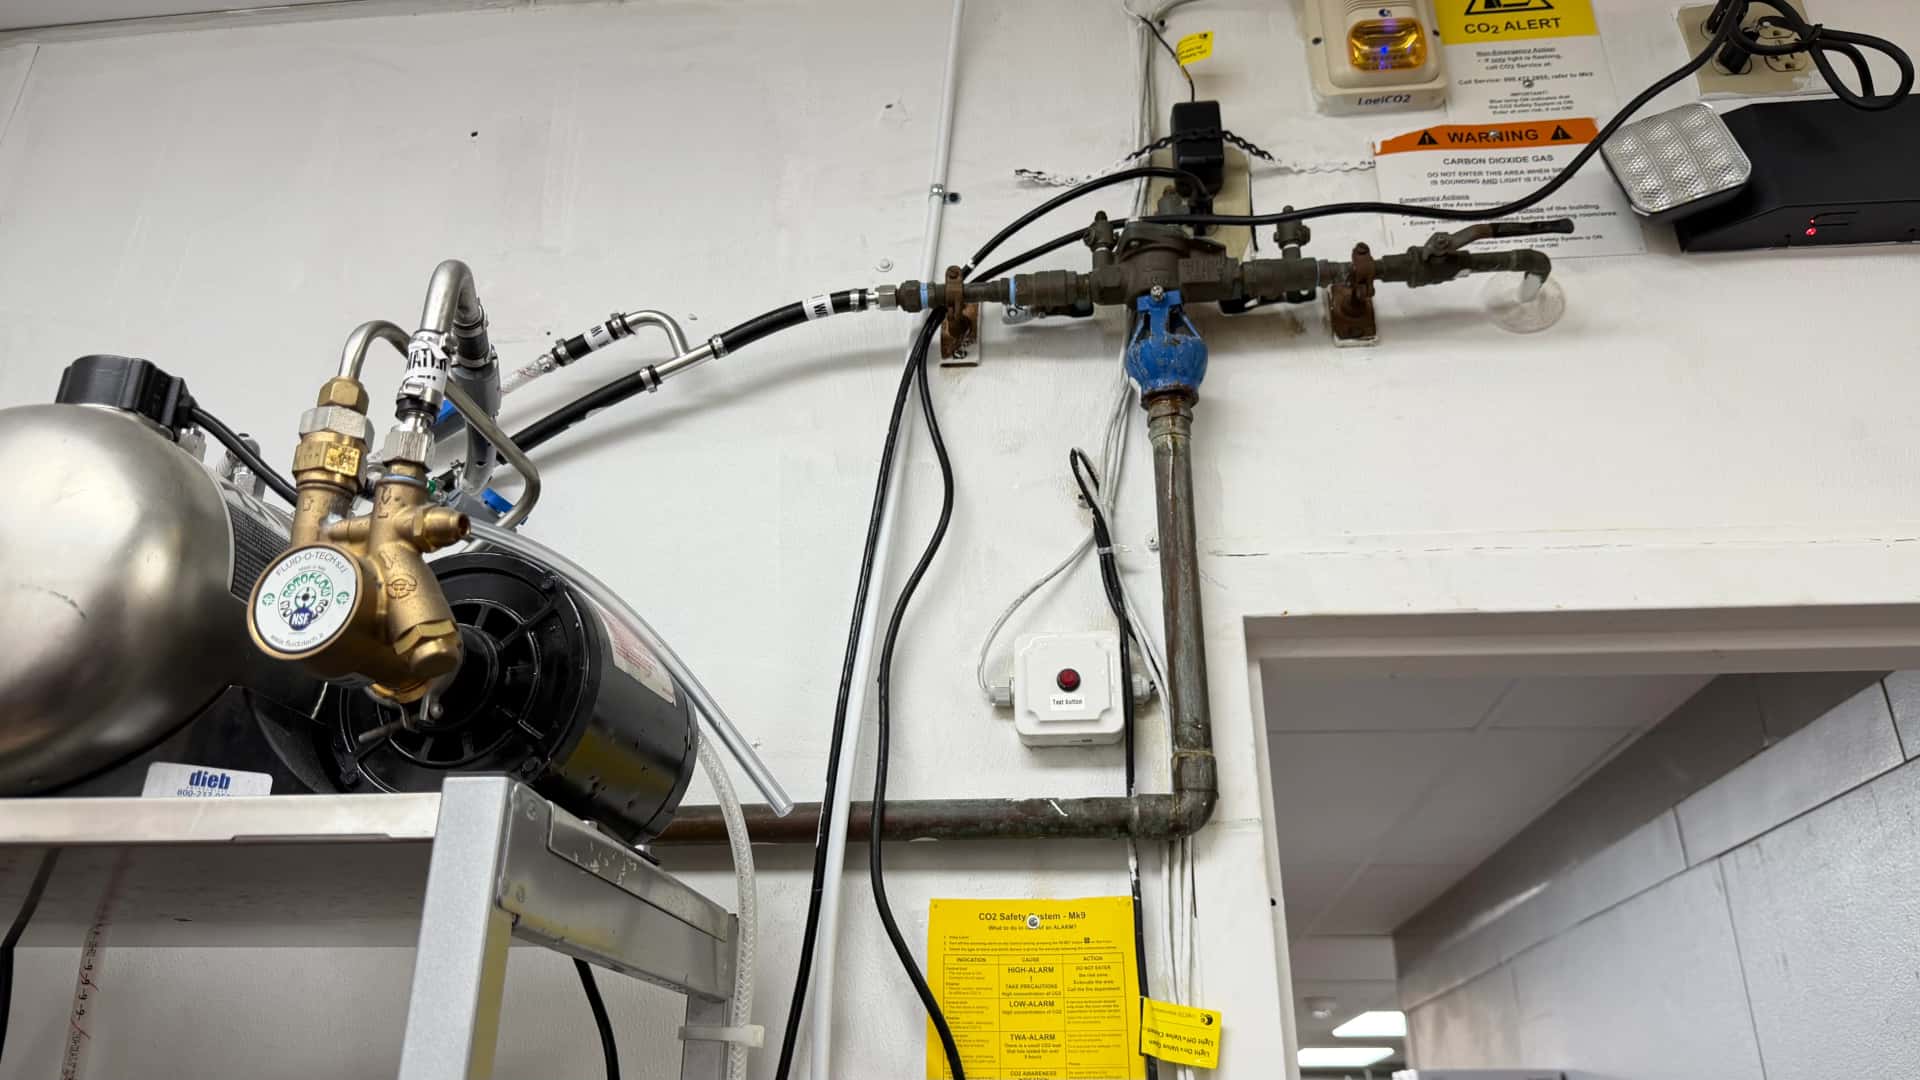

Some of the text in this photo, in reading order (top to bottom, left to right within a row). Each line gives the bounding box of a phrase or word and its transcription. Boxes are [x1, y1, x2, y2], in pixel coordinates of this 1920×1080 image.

[1464, 17, 1561, 34] CO2 ALERT
[1447, 128, 1539, 144] WARNING
[1442, 153, 1554, 166] CARBON DIOXIDE GAS
[1486, 169, 1503, 177] THIS
[1504, 168, 1525, 176] AREA
[1527, 167, 1551, 175] WHEN
[1440, 178, 1480, 186] SOUNDING
[1481, 177, 1498, 186] AND
[1499, 176, 1522, 184] LIGHT
[1525, 175, 1532, 183] IS
[291, 612, 310, 625] NSF
[1052, 698, 1065, 706] Test
[978, 912, 998, 922] CO2
[999, 912, 1027, 923] Safety
[1068, 911, 1086, 920] Mk9
[1007, 965, 1055, 974] HIGH-ALARM
[1009, 1000, 1055, 1008] LOW-ALARM
[1010, 1033, 1056, 1041] TWA-ALARM
[1165, 1032, 1182, 1041] Valve
[1197, 1037, 1215, 1048] Light
[1194, 1048, 1210, 1057] Light
